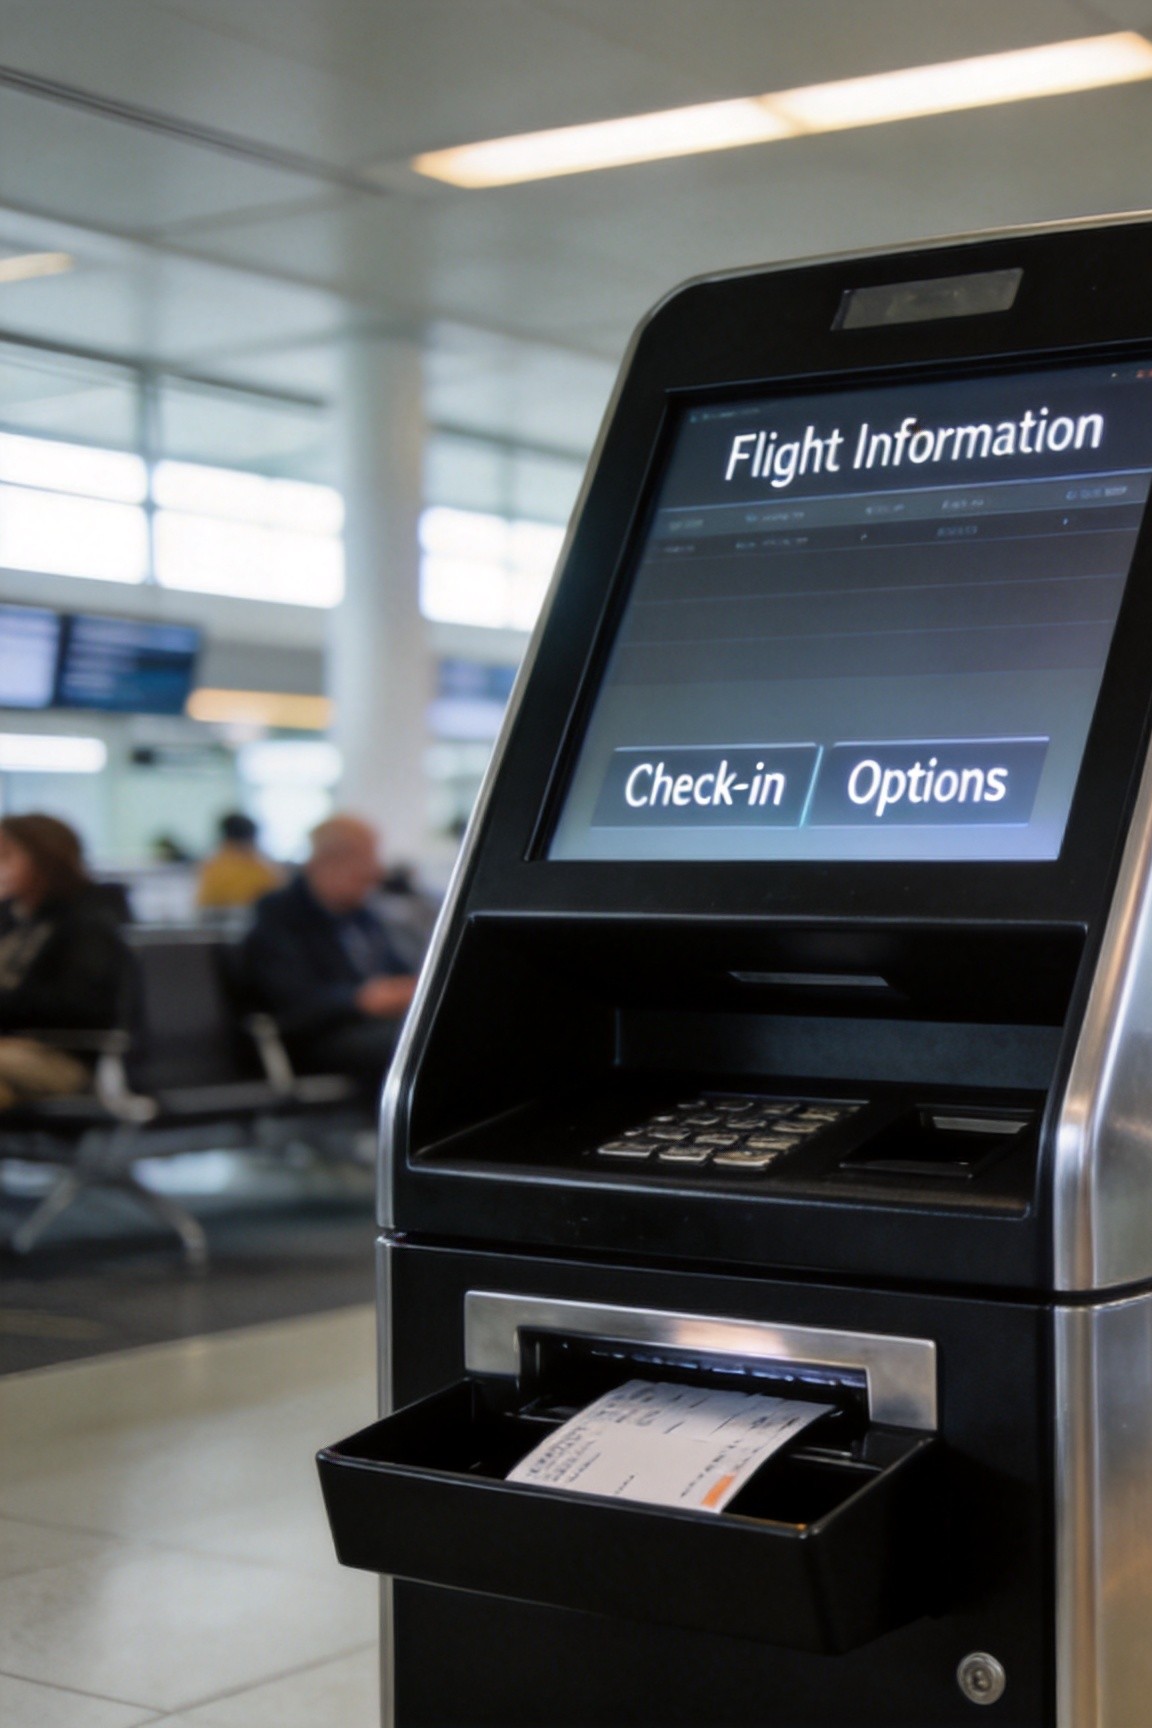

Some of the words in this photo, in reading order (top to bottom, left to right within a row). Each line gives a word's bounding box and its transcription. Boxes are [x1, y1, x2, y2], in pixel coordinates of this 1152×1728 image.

[724, 425, 844, 488] Flight
[853, 407, 1104, 470] Information
[624, 760, 786, 807] Check-in
[846, 757, 1009, 818] Options
